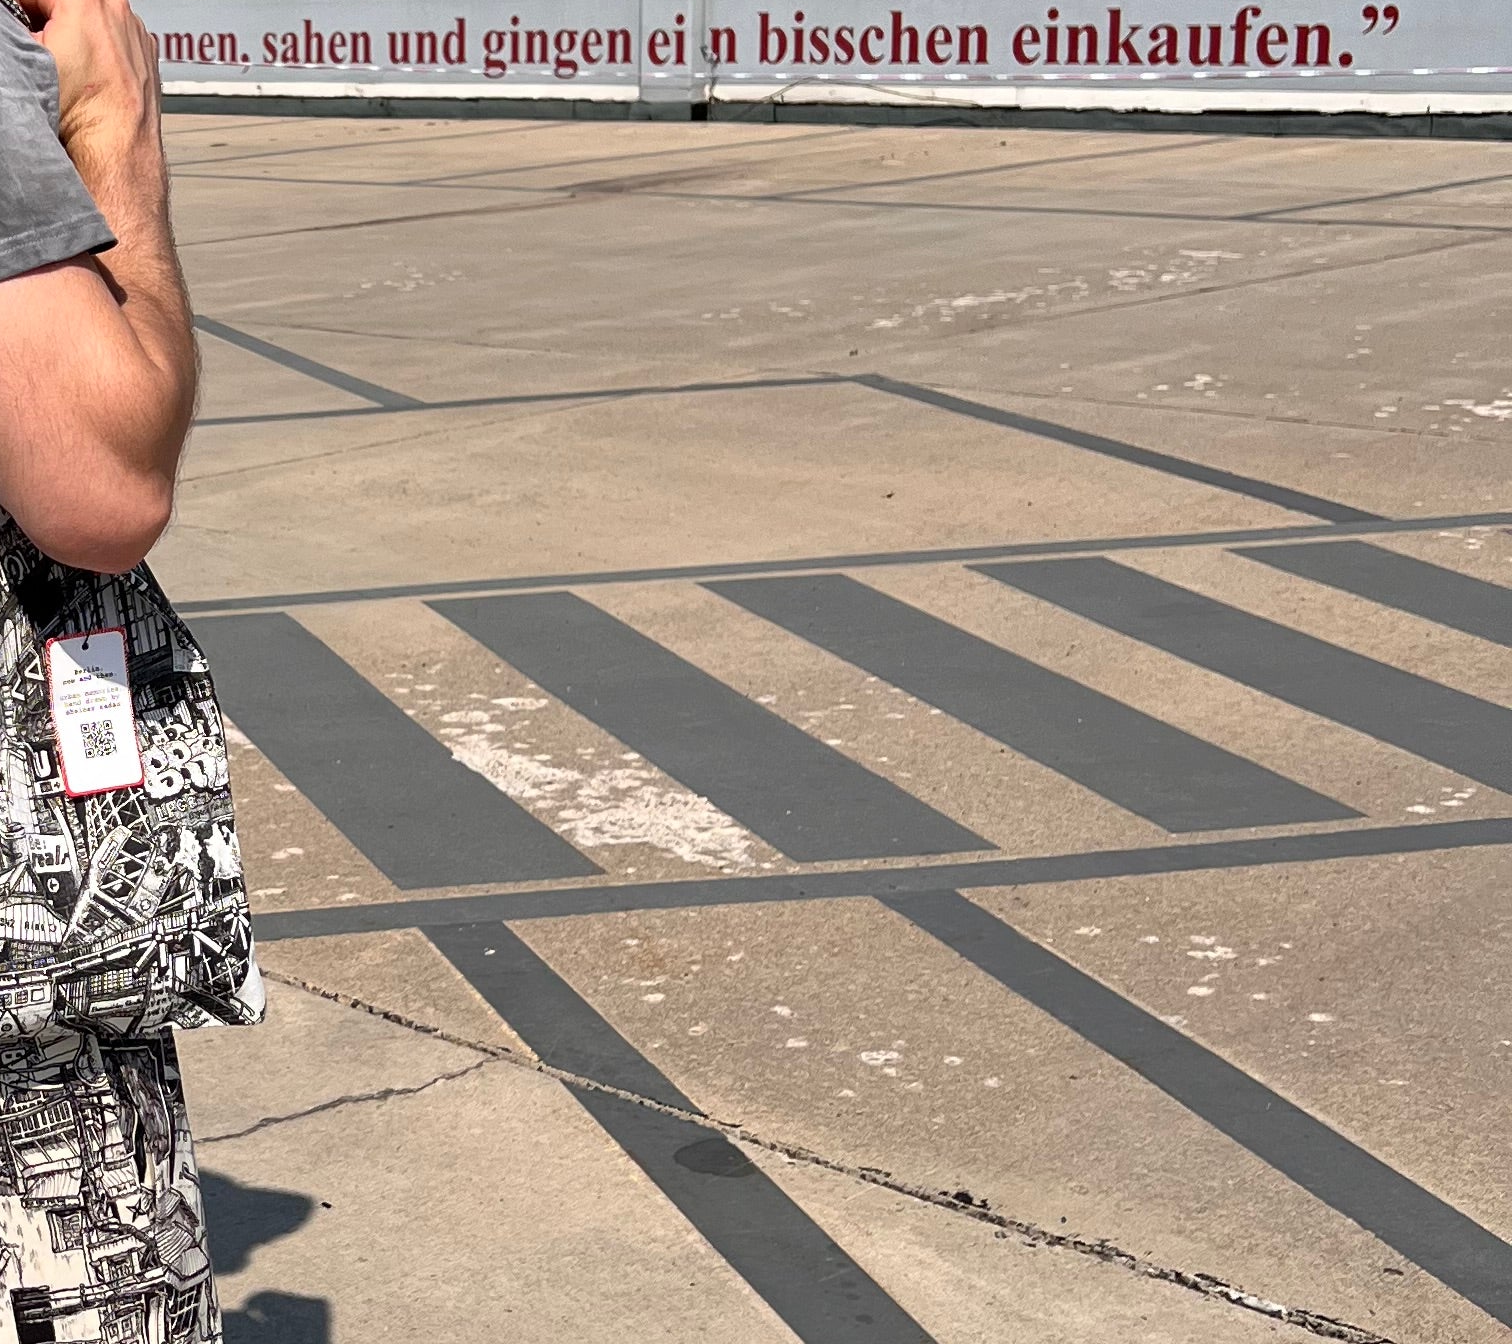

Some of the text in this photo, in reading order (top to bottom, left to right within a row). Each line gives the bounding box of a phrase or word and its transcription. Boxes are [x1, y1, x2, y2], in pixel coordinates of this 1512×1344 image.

[263, 18, 373, 65] sahen
[386, 16, 467, 66] und
[483, 14, 634, 79] gingen
[757, 9, 989, 65] bisschen
